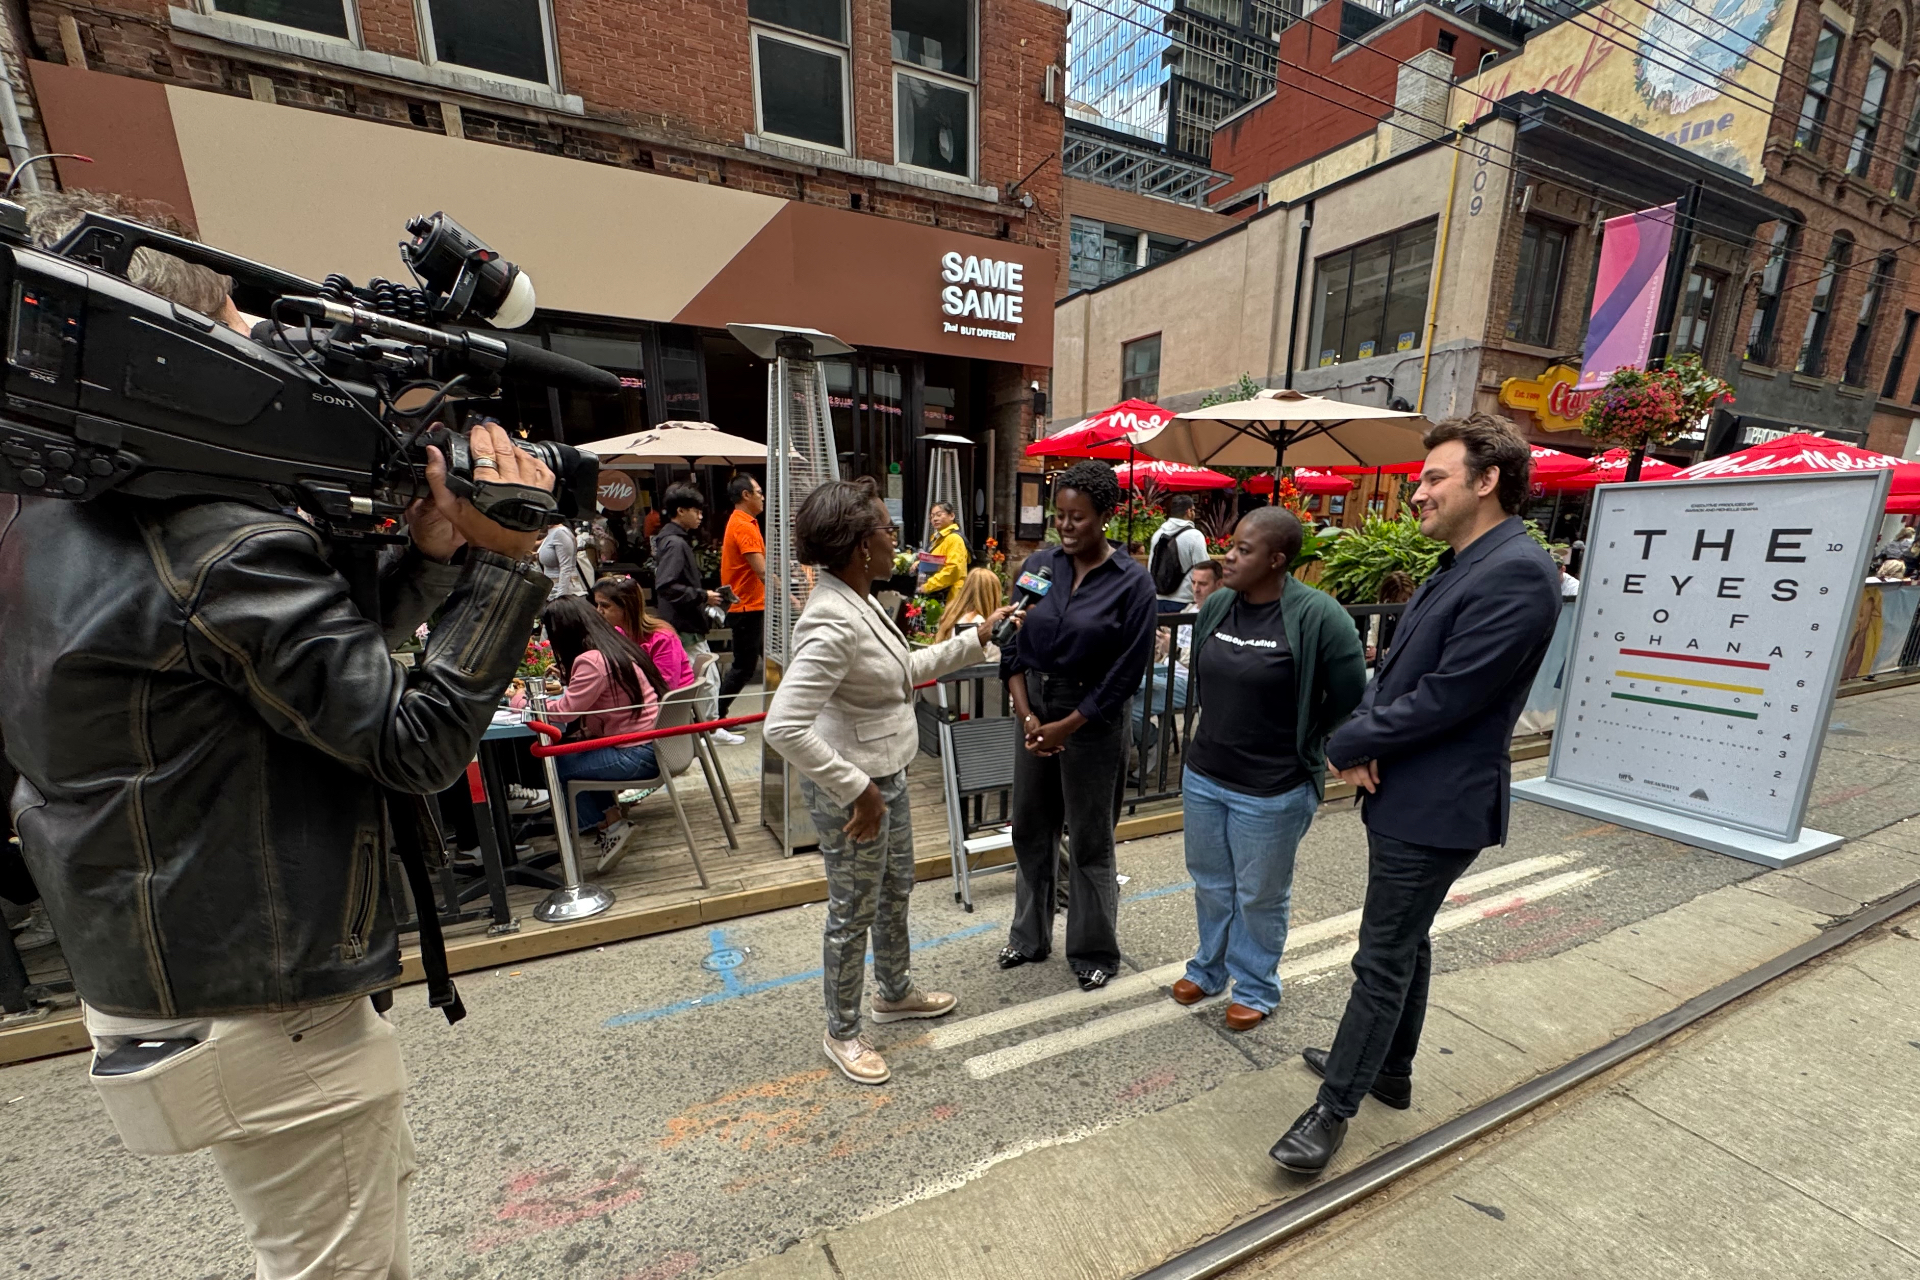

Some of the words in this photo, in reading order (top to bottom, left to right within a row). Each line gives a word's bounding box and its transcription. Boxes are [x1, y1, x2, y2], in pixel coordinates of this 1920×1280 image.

[1470, 146, 1490, 216] 309
[942, 251, 1024, 292] SAME
[942, 285, 1024, 324] SAME
[960, 325, 976, 337] BUT
[976, 328, 1016, 341] DIFFERENT
[312, 392, 355, 409] SONY
[1802, 449, 1909, 472] Molson
[1633, 528, 1813, 563] THE
[1826, 543, 1844, 552] 10
[1622, 574, 1799, 602] EYES
[1819, 586, 1829, 596] 9
[1810, 622, 1820, 632] 8
[1804, 650, 1813, 659] 7
[1796, 679, 1805, 688] 6
[1790, 704, 1799, 713] 5
[1782, 733, 1791, 741] 4
[1778, 750, 1787, 759] 3
[1773, 770, 1782, 779] 2
[1769, 788, 1777, 798] 1
